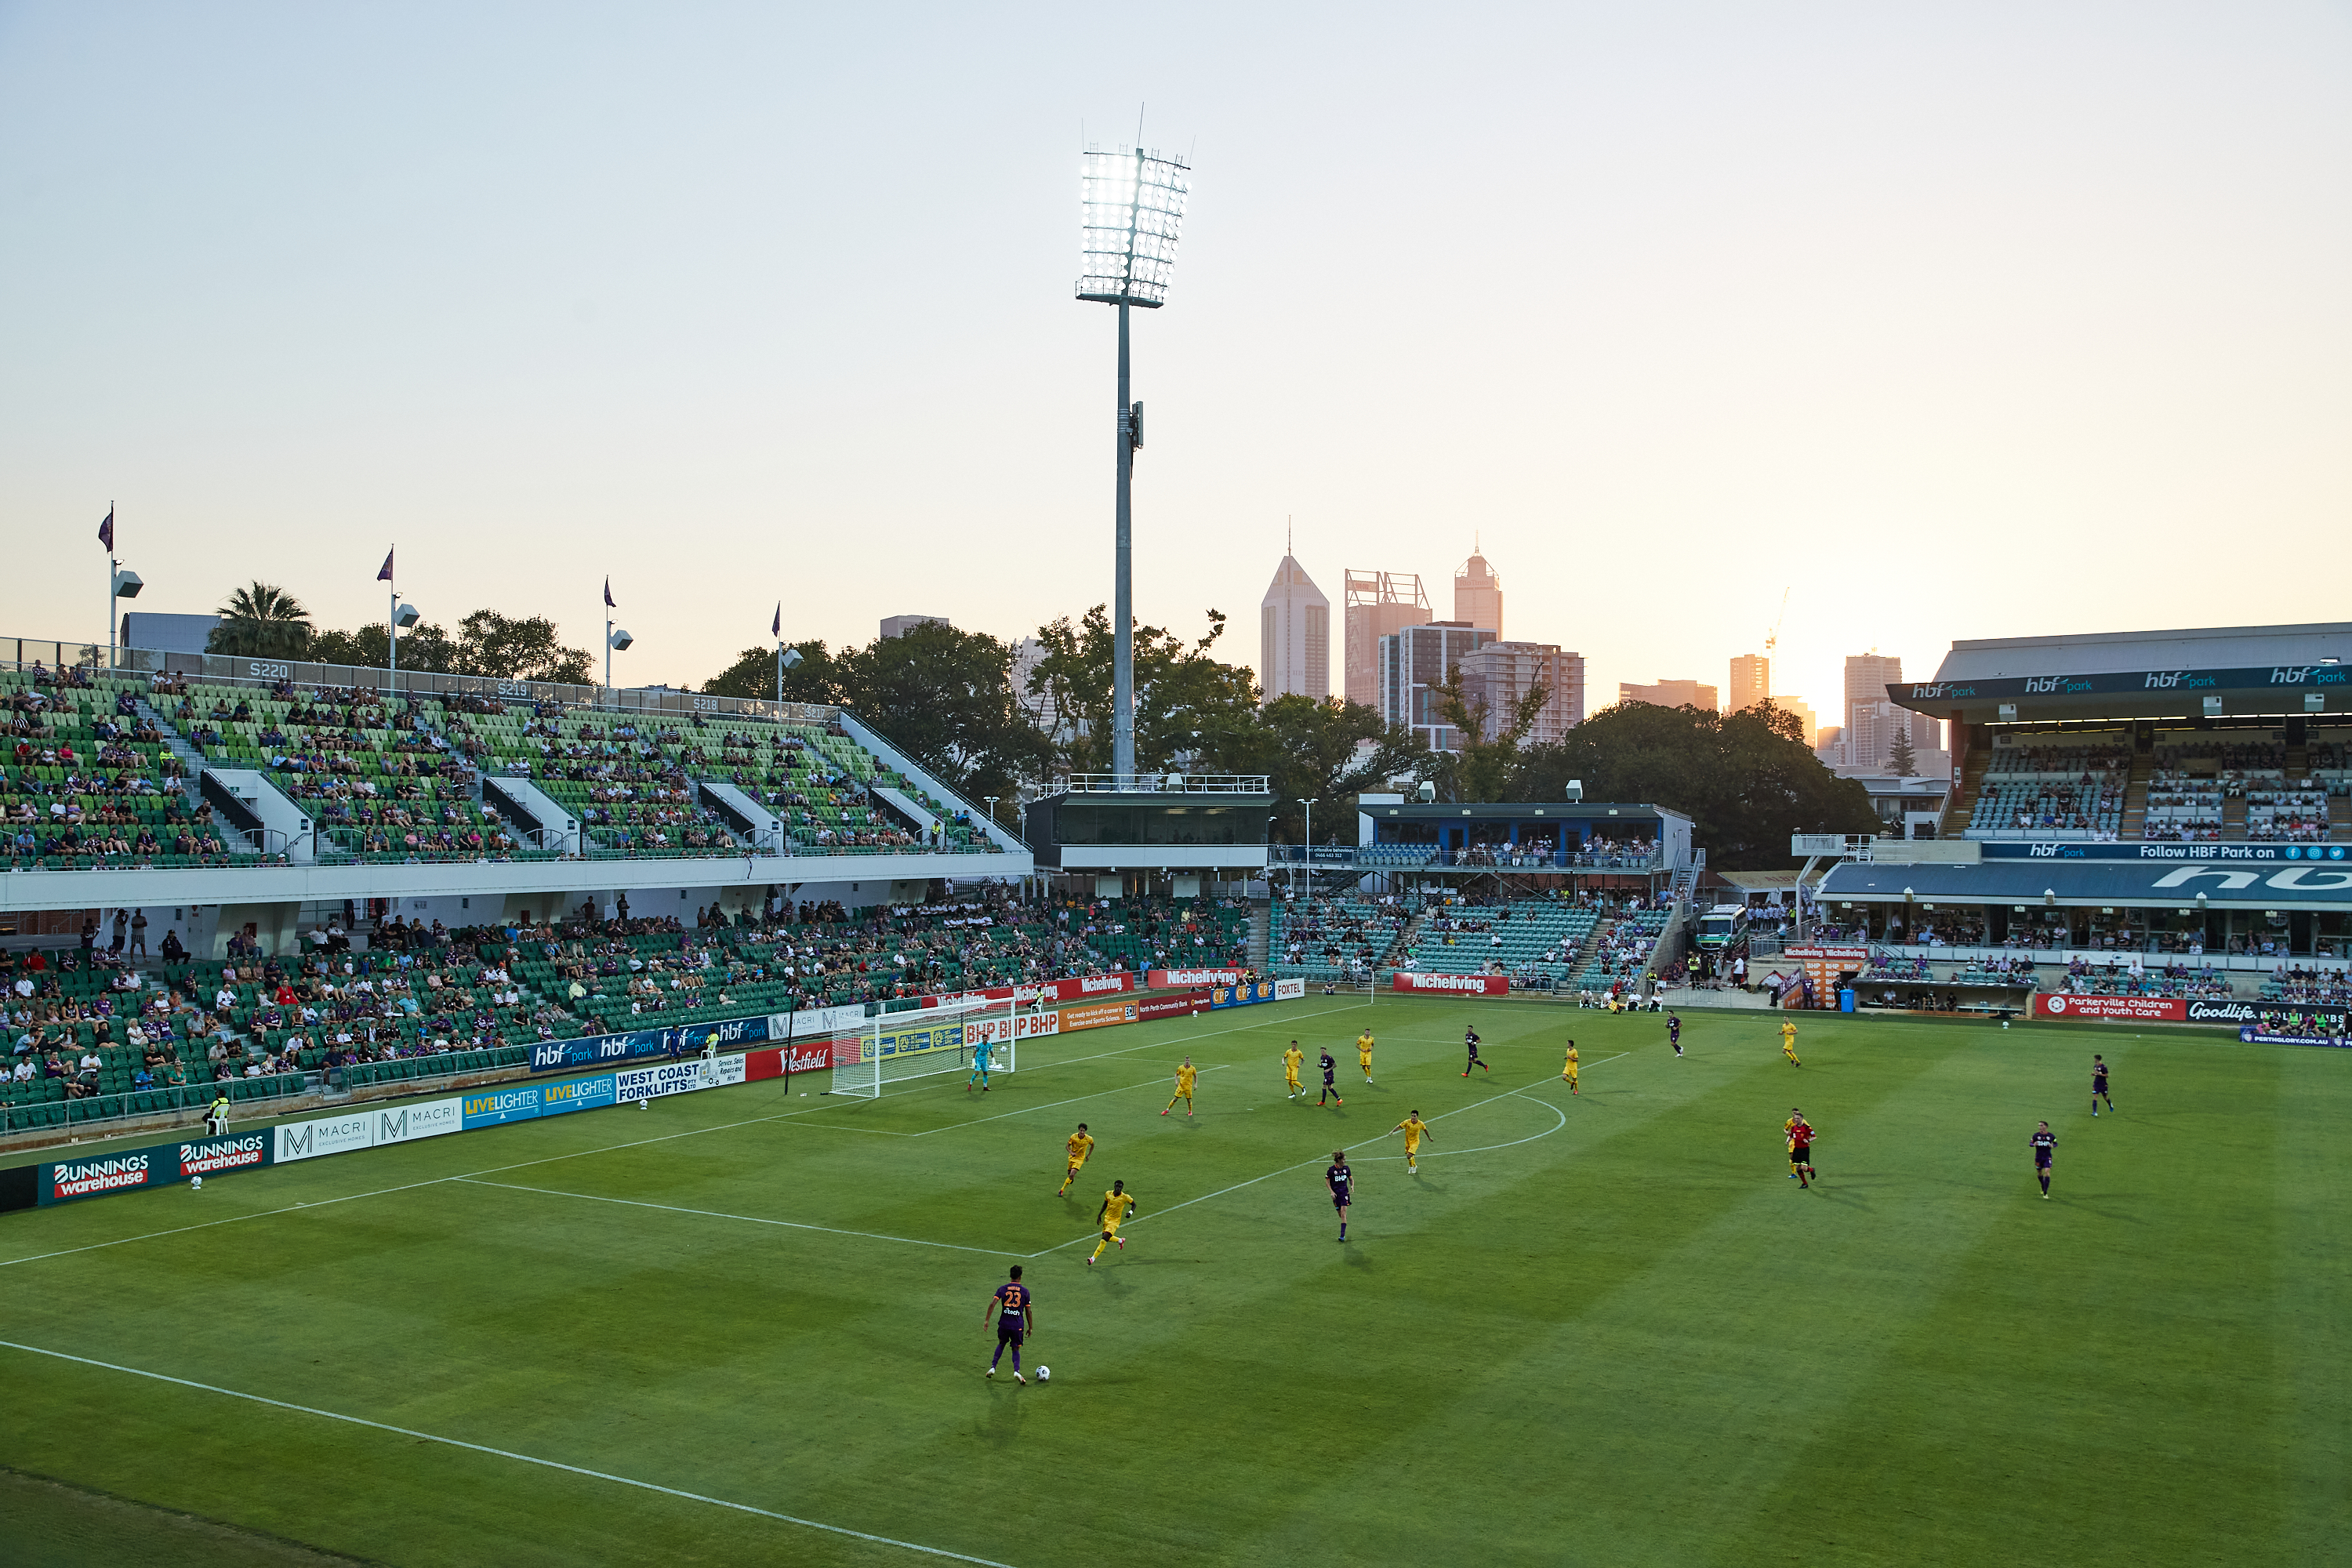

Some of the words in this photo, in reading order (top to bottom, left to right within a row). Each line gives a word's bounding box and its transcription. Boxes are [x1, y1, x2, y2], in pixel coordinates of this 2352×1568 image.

[250, 663, 287, 678] S220
[2270, 667, 2310, 683] hbf
[2318, 671, 2345, 685] park
[2025, 676, 2060, 692] hbf
[2067, 680, 2092, 693] park
[2145, 672, 2181, 688] hbf
[2189, 676, 2216, 689] park
[1912, 682, 1945, 698] hbf
[1952, 686, 1975, 699] park
[2030, 844, 2059, 857] hbf
[2064, 848, 2085, 858] park
[2140, 846, 2186, 858] Follow
[2189, 846, 2217, 858] HBF
[2221, 846, 2253, 858] Park
[2256, 848, 2274, 858] on
[1785, 949, 1823, 957] Nicheliving
[1827, 949, 1865, 958] Nicheliving
[1082, 976, 1122, 993] Nicheliving
[1167, 970, 1236, 985] Nicheliving
[1413, 974, 1485, 993] Nicheliving
[1013, 984, 1058, 1000] Nichelving
[1214, 991, 1229, 1001] CPP
[1237, 988, 1251, 998] CPP
[1258, 985, 1272, 995] CPP
[1278, 983, 1300, 995] FOXTEL
[1125, 1006, 1135, 1016] ECU
[1160, 1002, 1179, 1010] Community
[2069, 998, 2125, 1007] Parkerville
[2128, 999, 2173, 1009] Children
[2102, 1006, 2132, 1015] Youth
[2136, 1008, 2161, 1016] Care
[720, 1022, 743, 1041] hbf
[749, 1025, 765, 1040] park
[1030, 1014, 1057, 1034] BHP
[967, 1022, 995, 1044] BHP
[2254, 1036, 2328, 1045] PERTHGLORY.COM.AU
[535, 1044, 565, 1066] hbf
[572, 1048, 593, 1065] park
[600, 1036, 628, 1057] hbf
[635, 1040, 654, 1056] park
[779, 1047, 828, 1074] Westfield
[618, 1071, 654, 1087] WEST
[658, 1064, 699, 1080] COAST
[720, 1065, 734, 1075] Repairs
[546, 1079, 612, 1102] LIVELIGHTER
[619, 1079, 687, 1101] FORKLIFTS
[466, 1090, 538, 1114] LIVELIGHTER
[413, 1107, 455, 1122] MACRI
[319, 1121, 366, 1138] MACRI
[180, 1136, 263, 1162] BUNNINGS
[319, 1138, 346, 1146] EXCLUSIVE
[54, 1155, 148, 1184] BUNNINGS
[186, 1151, 259, 1173] warehouse
[61, 1171, 143, 1195] warehouse
[1004, 1291, 1021, 1307] 23
